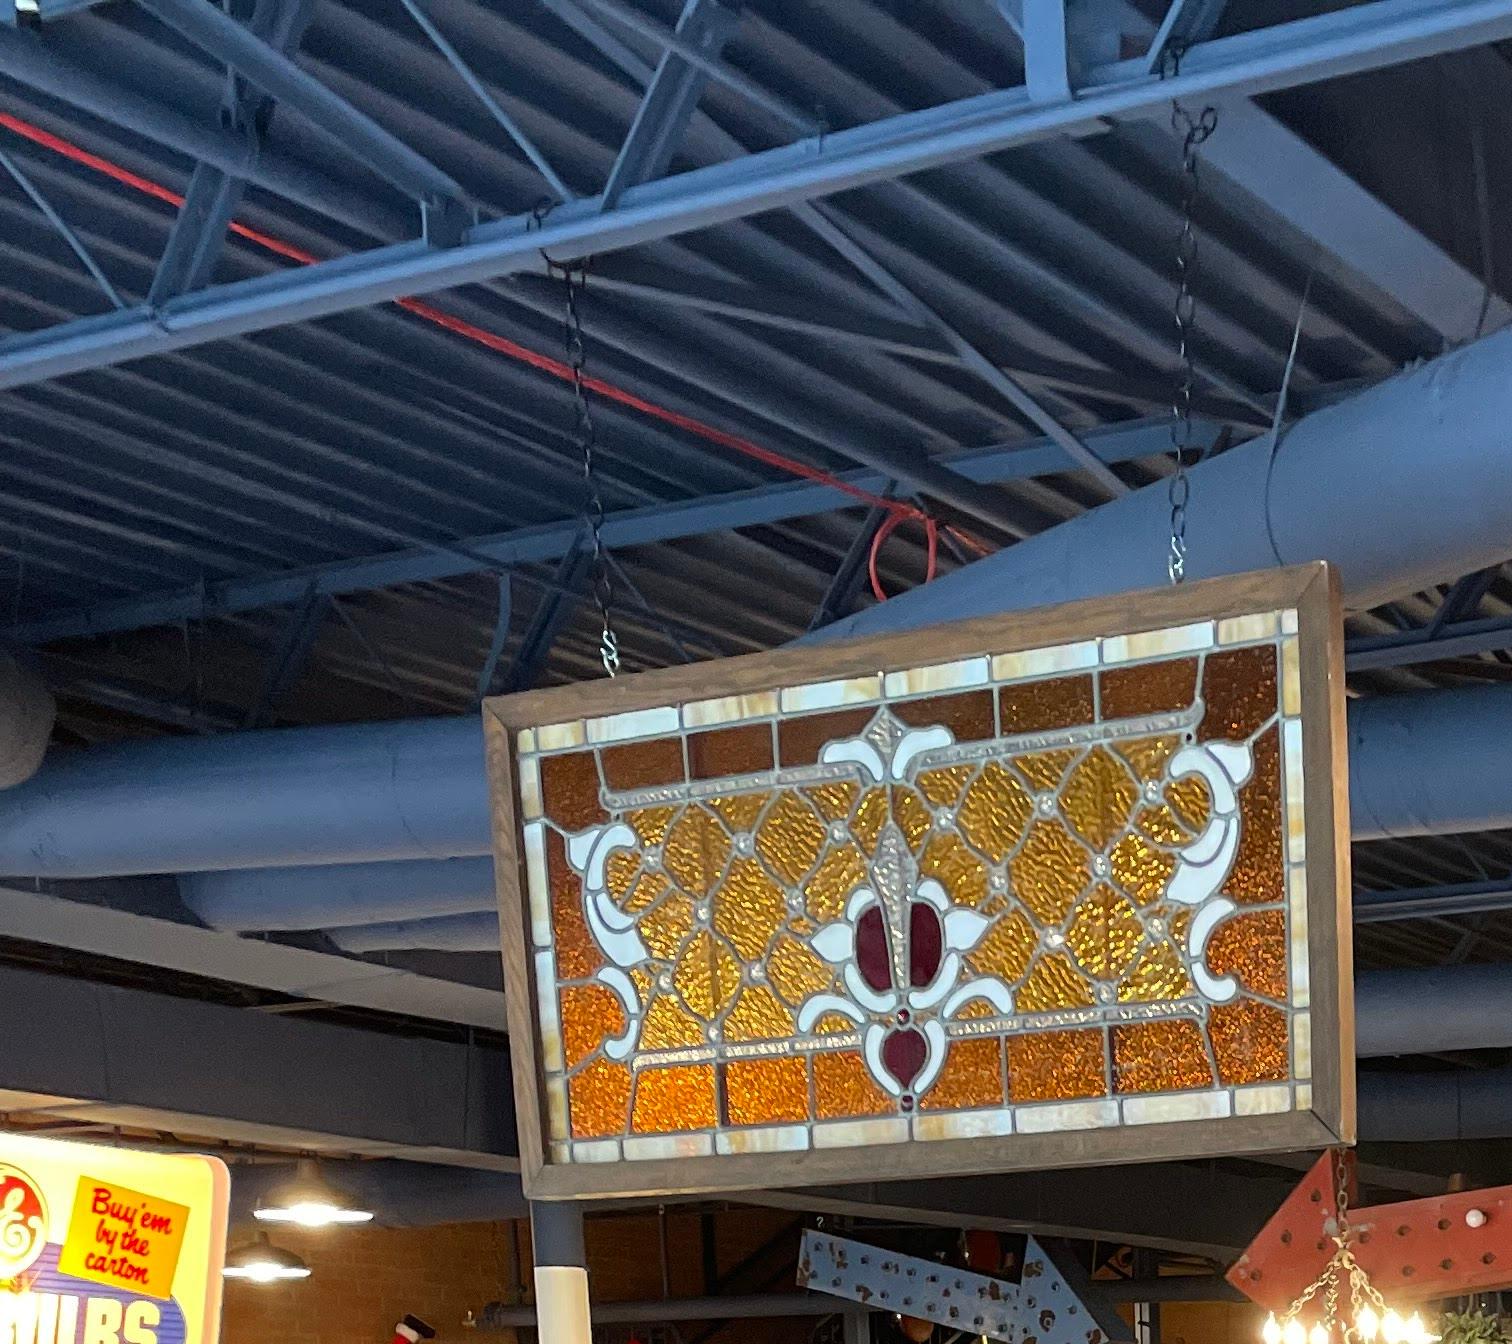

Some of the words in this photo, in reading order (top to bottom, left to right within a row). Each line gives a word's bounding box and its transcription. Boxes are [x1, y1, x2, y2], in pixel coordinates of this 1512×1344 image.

[92, 1187, 138, 1228] Buy
[140, 1203, 173, 1235] 'em
[95, 1218, 119, 1254] by
[120, 1229, 150, 1257] the
[85, 1251, 150, 1286] carton
